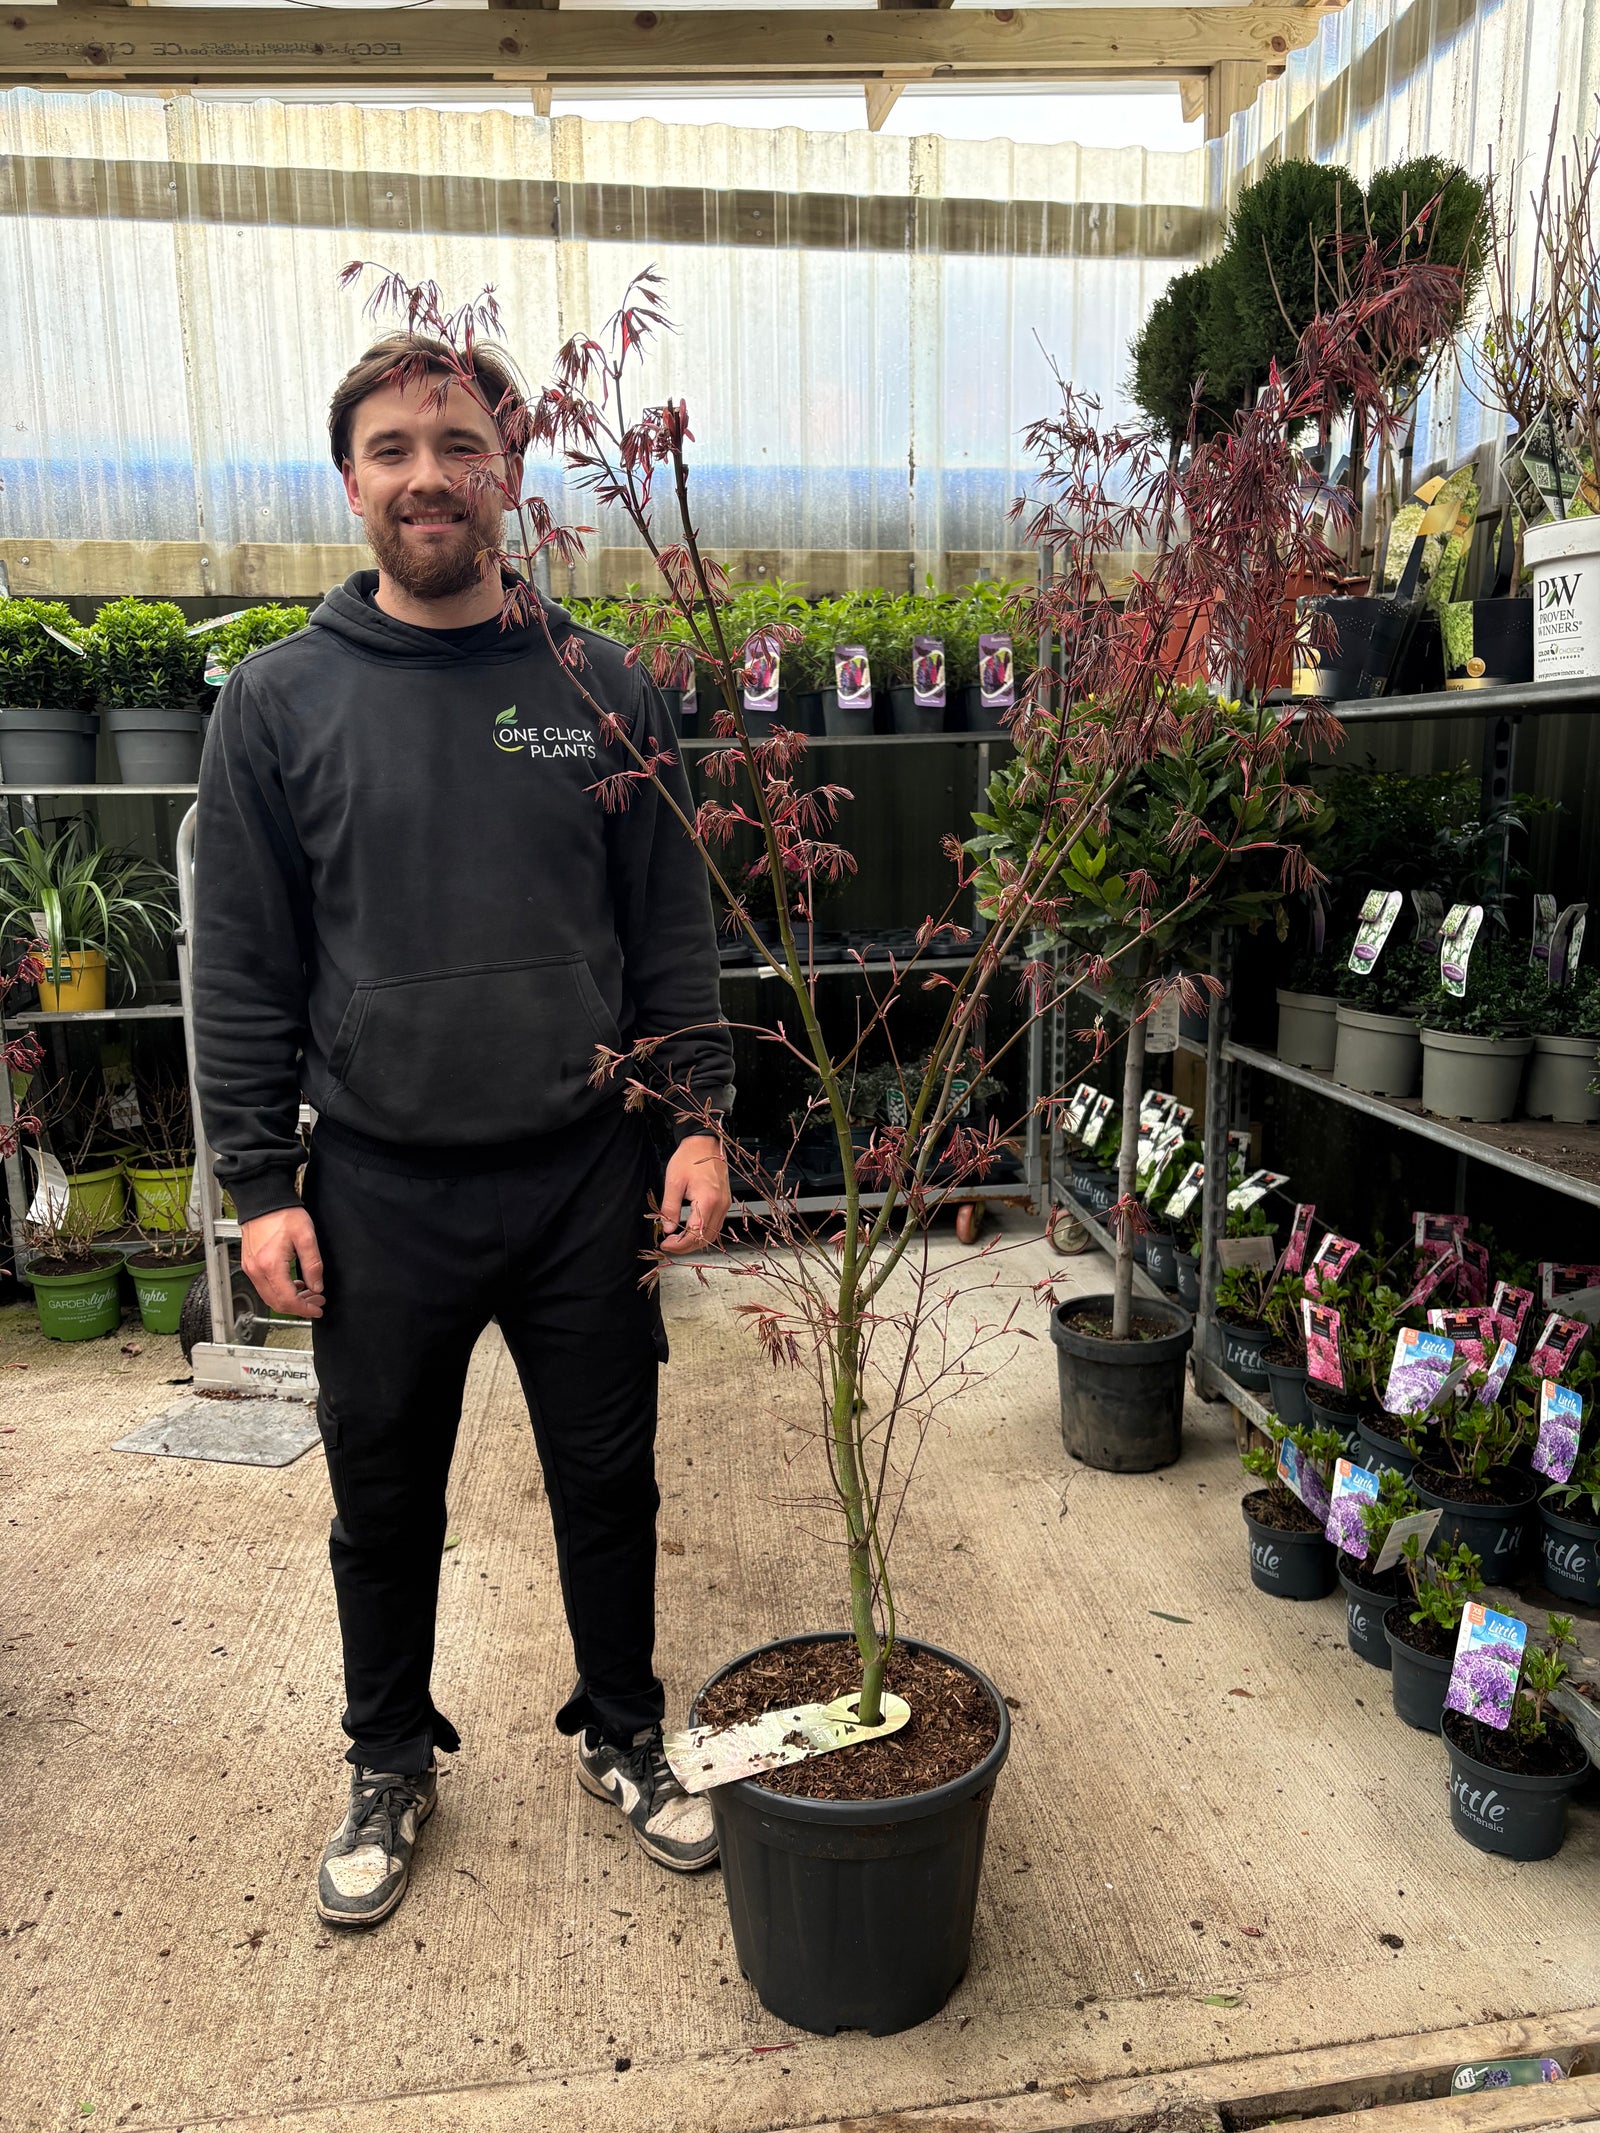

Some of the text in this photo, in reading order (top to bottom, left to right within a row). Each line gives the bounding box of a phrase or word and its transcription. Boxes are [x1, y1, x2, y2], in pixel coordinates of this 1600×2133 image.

[150, 42, 182, 56] CE
[357, 43, 403, 56] ECC
[1538, 573, 1583, 611] PW
[1539, 609, 1576, 625] PROVEN
[499, 727, 595, 744] ONE CLICK
[530, 744, 596, 759] PLANTS
[1420, 1340, 1447, 1354] Little
[1557, 1394, 1577, 1409] Little
[1353, 1473, 1374, 1489] Little
[1541, 1533, 1587, 1573] ittle
[1488, 1620, 1518, 1640] Little
